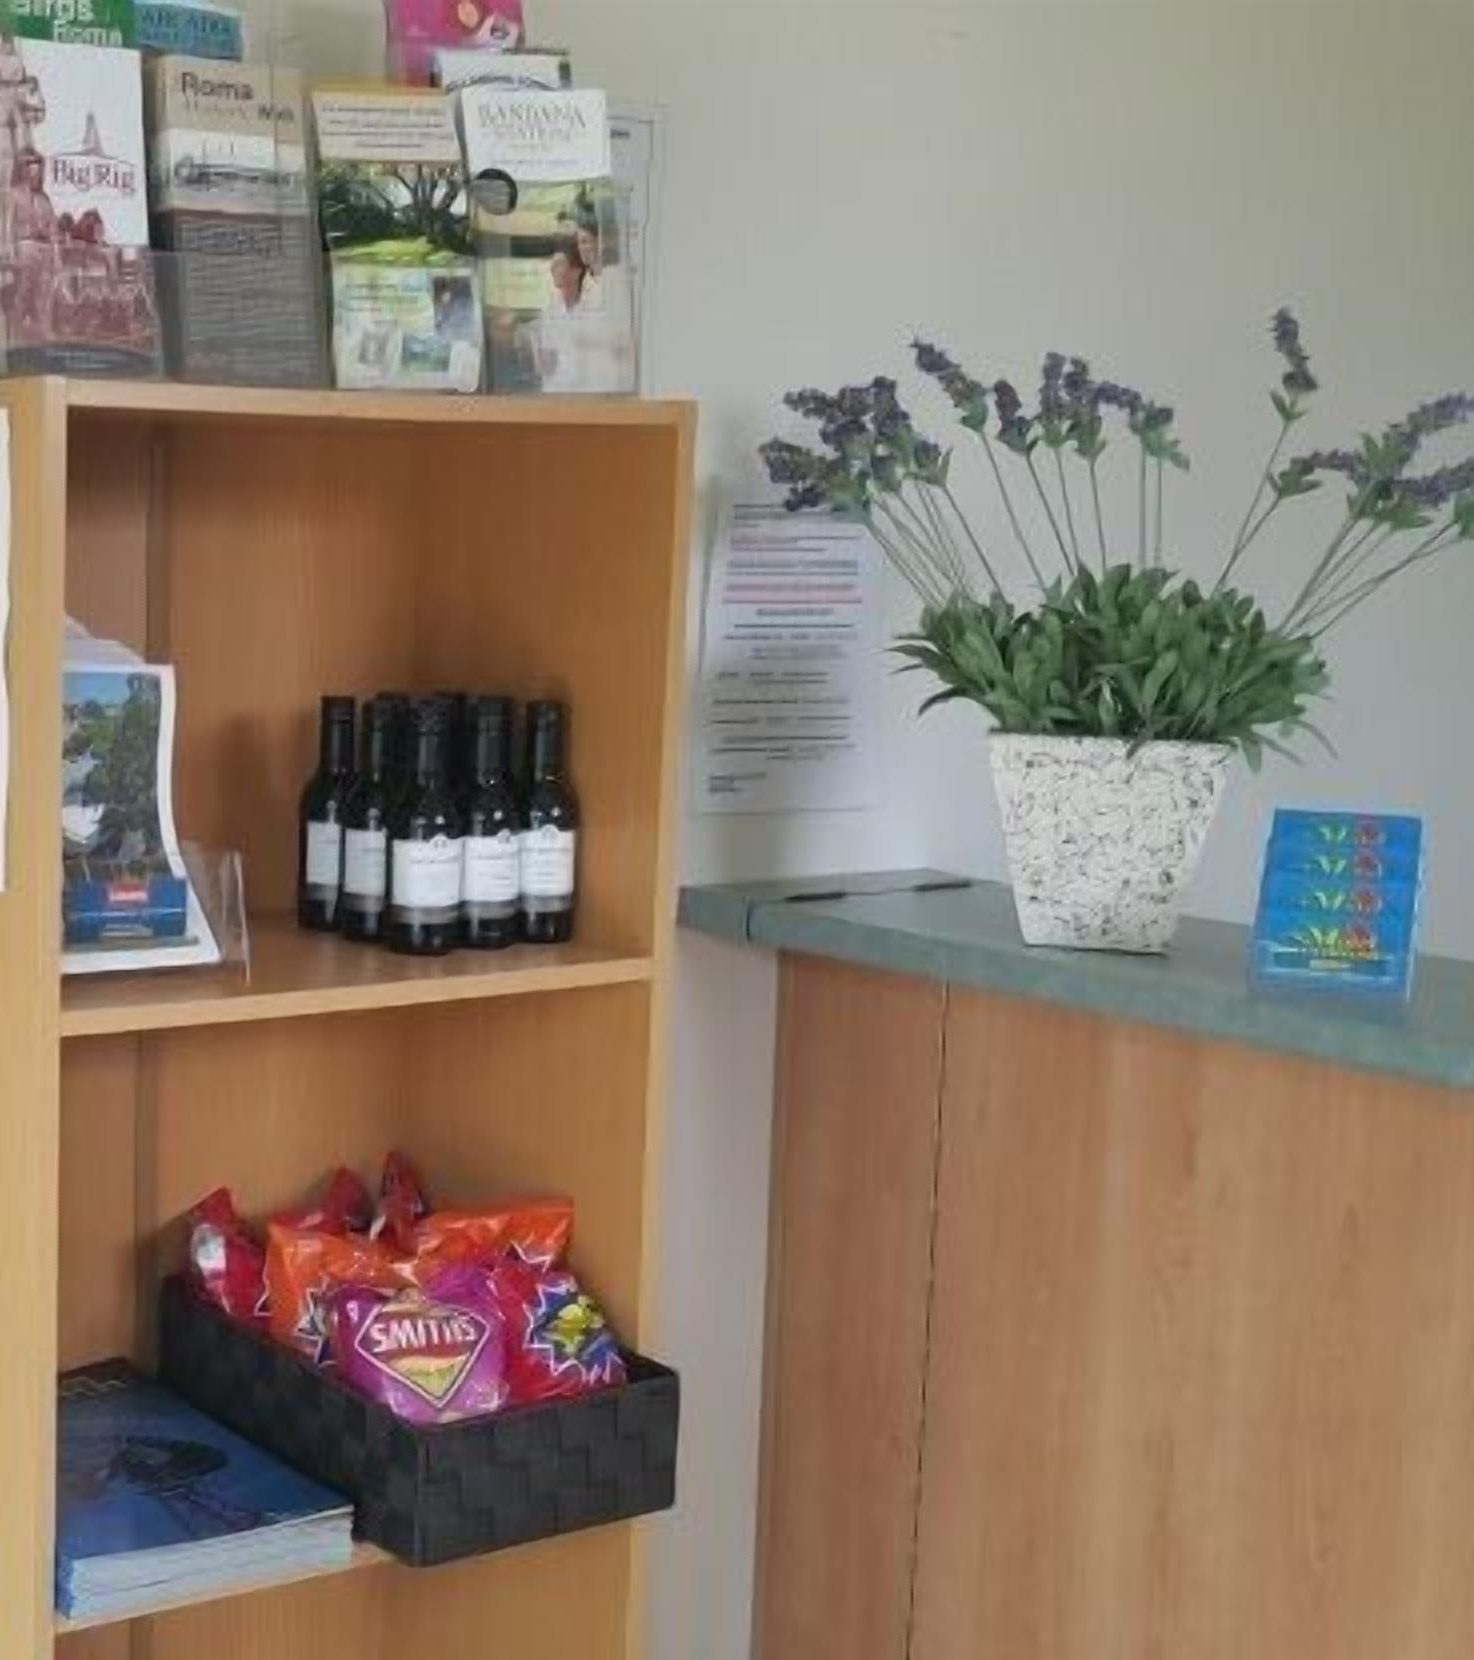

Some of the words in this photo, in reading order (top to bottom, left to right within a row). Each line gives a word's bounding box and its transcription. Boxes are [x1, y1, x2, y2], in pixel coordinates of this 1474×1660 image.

[180, 71, 255, 101] Roma
[52, 158, 91, 191] Big
[94, 160, 137, 194] Rig
